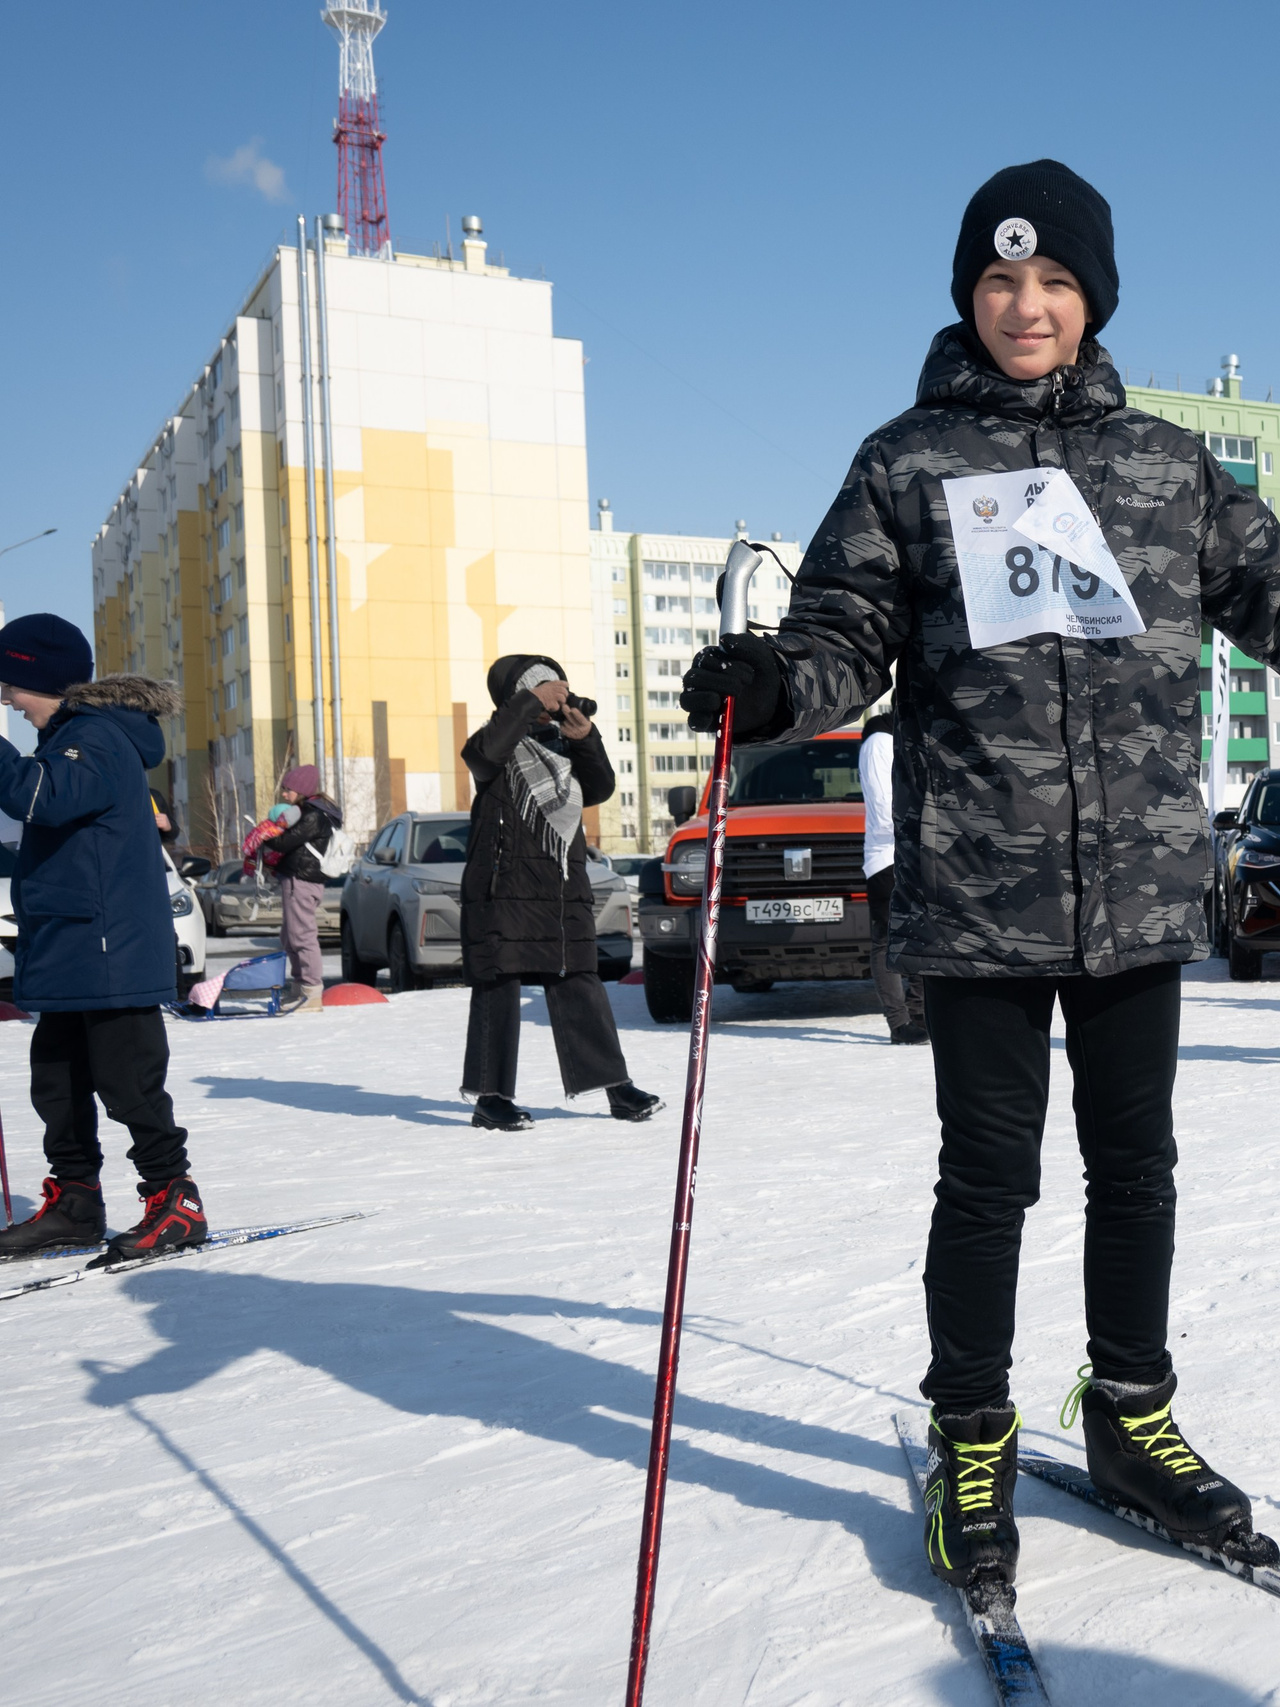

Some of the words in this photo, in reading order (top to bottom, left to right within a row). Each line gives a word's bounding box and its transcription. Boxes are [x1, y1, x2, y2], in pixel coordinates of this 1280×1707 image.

[1000, 223, 1029, 237] CONVERSE
[1004, 248, 1015, 257] ALL
[1016, 247, 1029, 257] STAR
[1125, 497, 1165, 508] Columbia
[1065, 613, 1123, 625] ЧЕЛЯБИНСКАЯ
[1066, 624, 1102, 635] ОБЛАСТЬ
[815, 900, 839, 911] 774
[676, 1222, 690, 1231] 1.25
